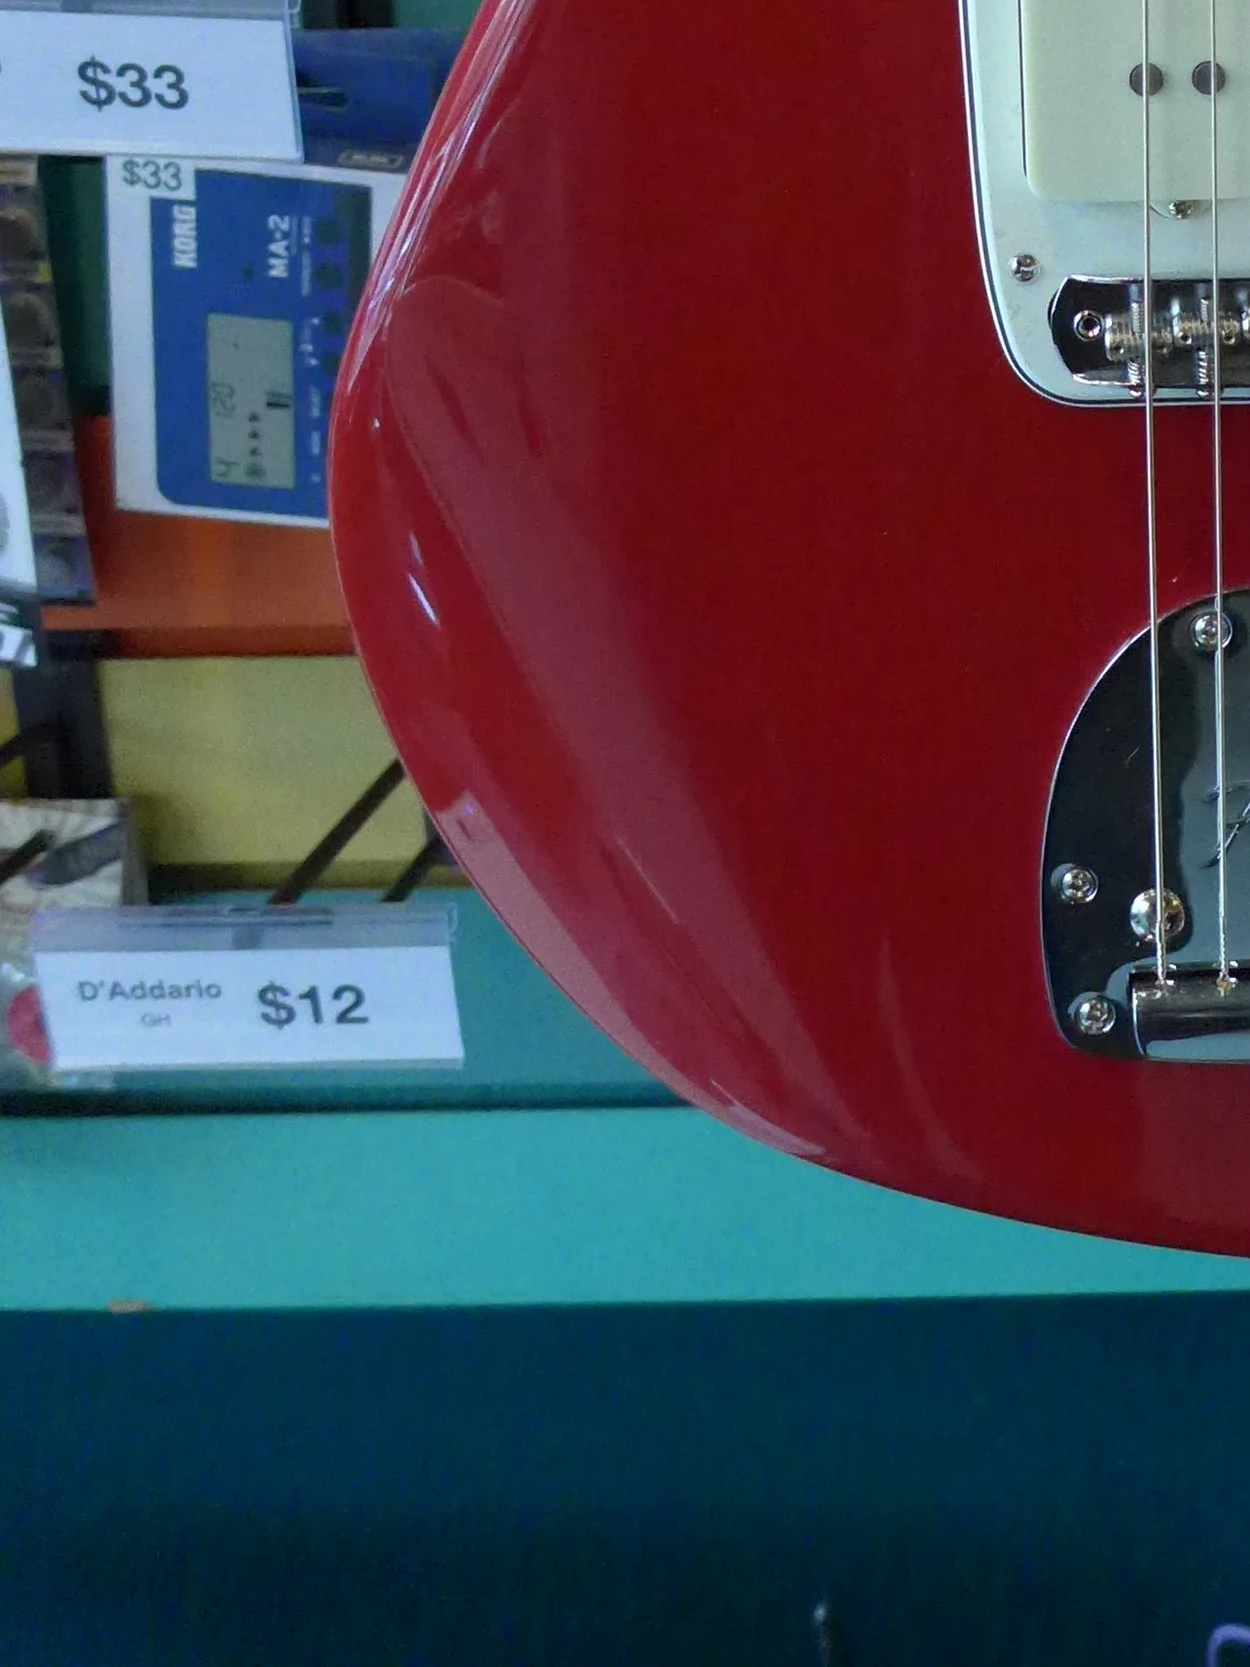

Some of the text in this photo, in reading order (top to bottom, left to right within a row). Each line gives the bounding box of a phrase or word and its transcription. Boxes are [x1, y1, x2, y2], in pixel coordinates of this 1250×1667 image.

[78, 55, 189, 112] $33
[123, 158, 182, 191] $33
[172, 205, 197, 268] KORG
[267, 214, 290, 278] MA-2
[78, 979, 370, 1029] D'Addario $12
